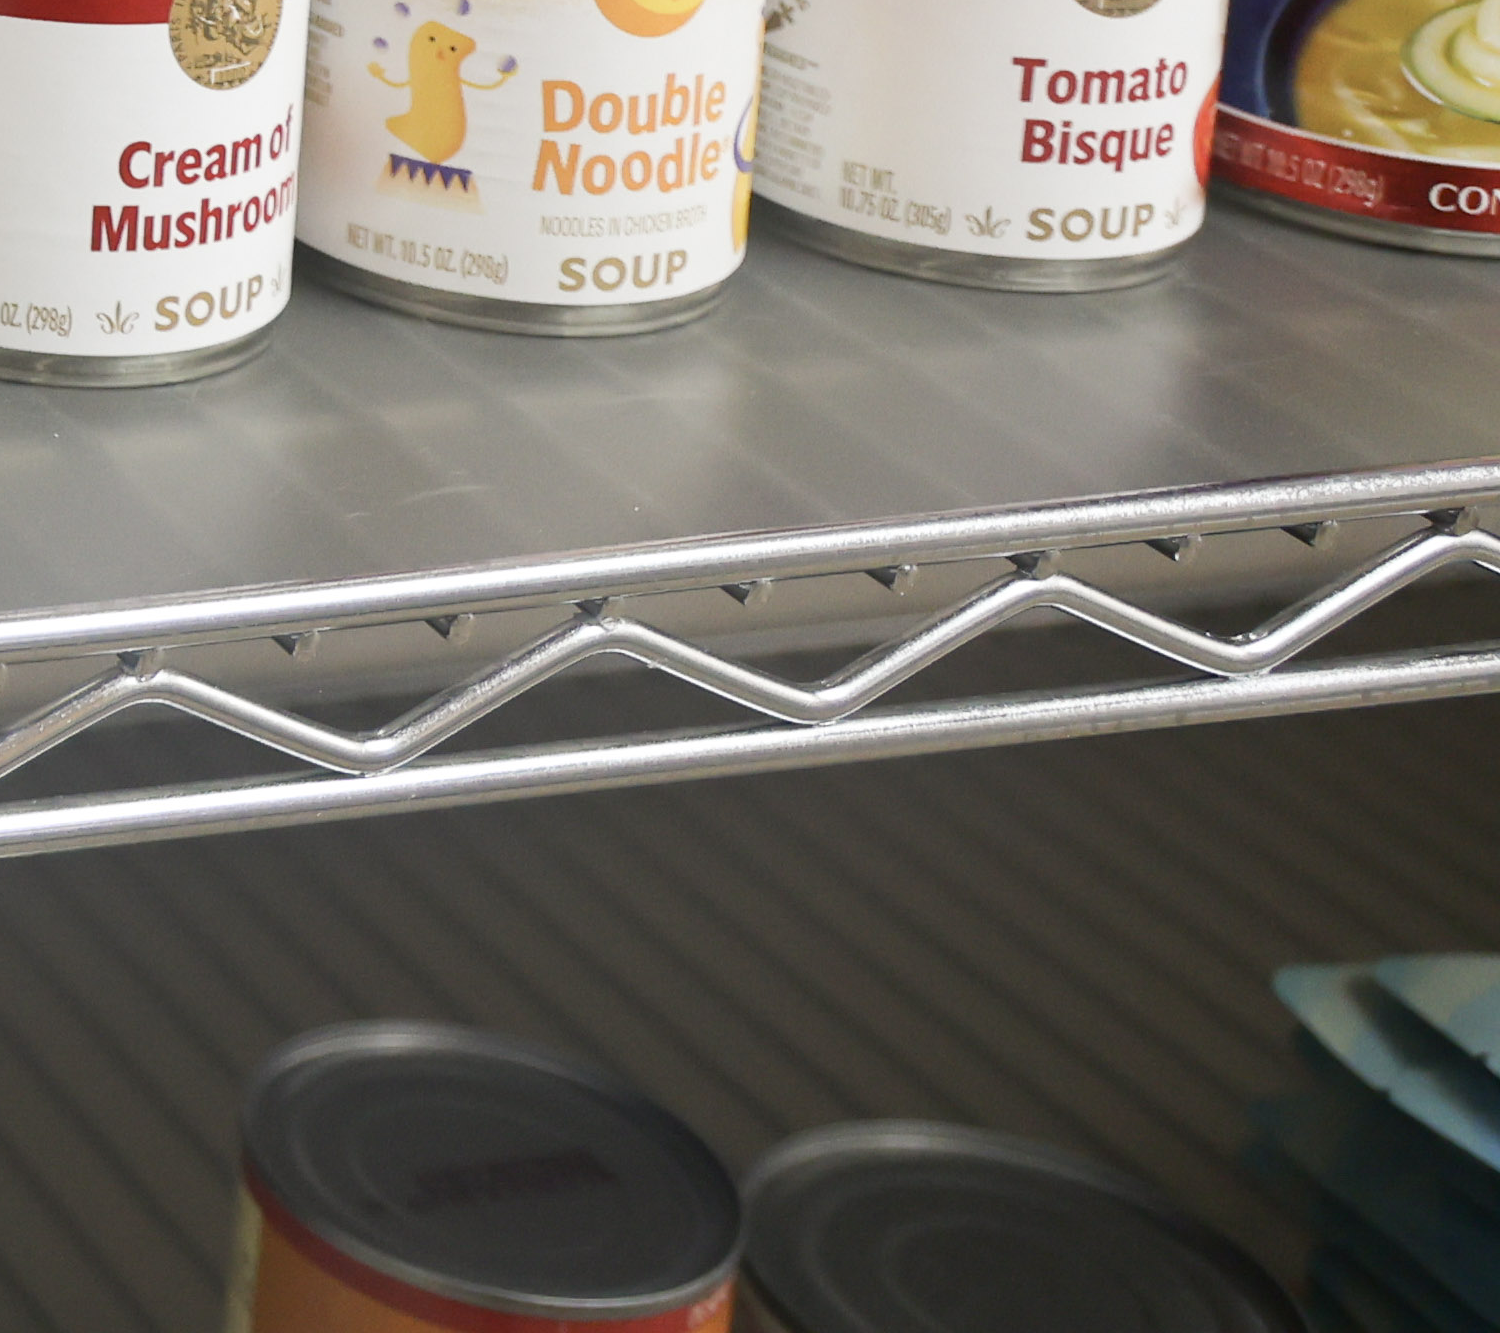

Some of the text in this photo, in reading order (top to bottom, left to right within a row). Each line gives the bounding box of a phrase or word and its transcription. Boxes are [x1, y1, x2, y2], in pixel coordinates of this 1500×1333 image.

[540, 73, 726, 136] Double
[1013, 57, 1188, 107] Tomato
[118, 103, 294, 190] Cream of
[530, 136, 722, 197] Noodle
[1020, 118, 1174, 174] Bisque
[89, 167, 298, 253] Mushroom
[1027, 203, 1155, 242] SOUP
[558, 249, 687, 292] SOUP
[26, 302, 73, 338] (298g)
[155, 274, 263, 332] SOUP
